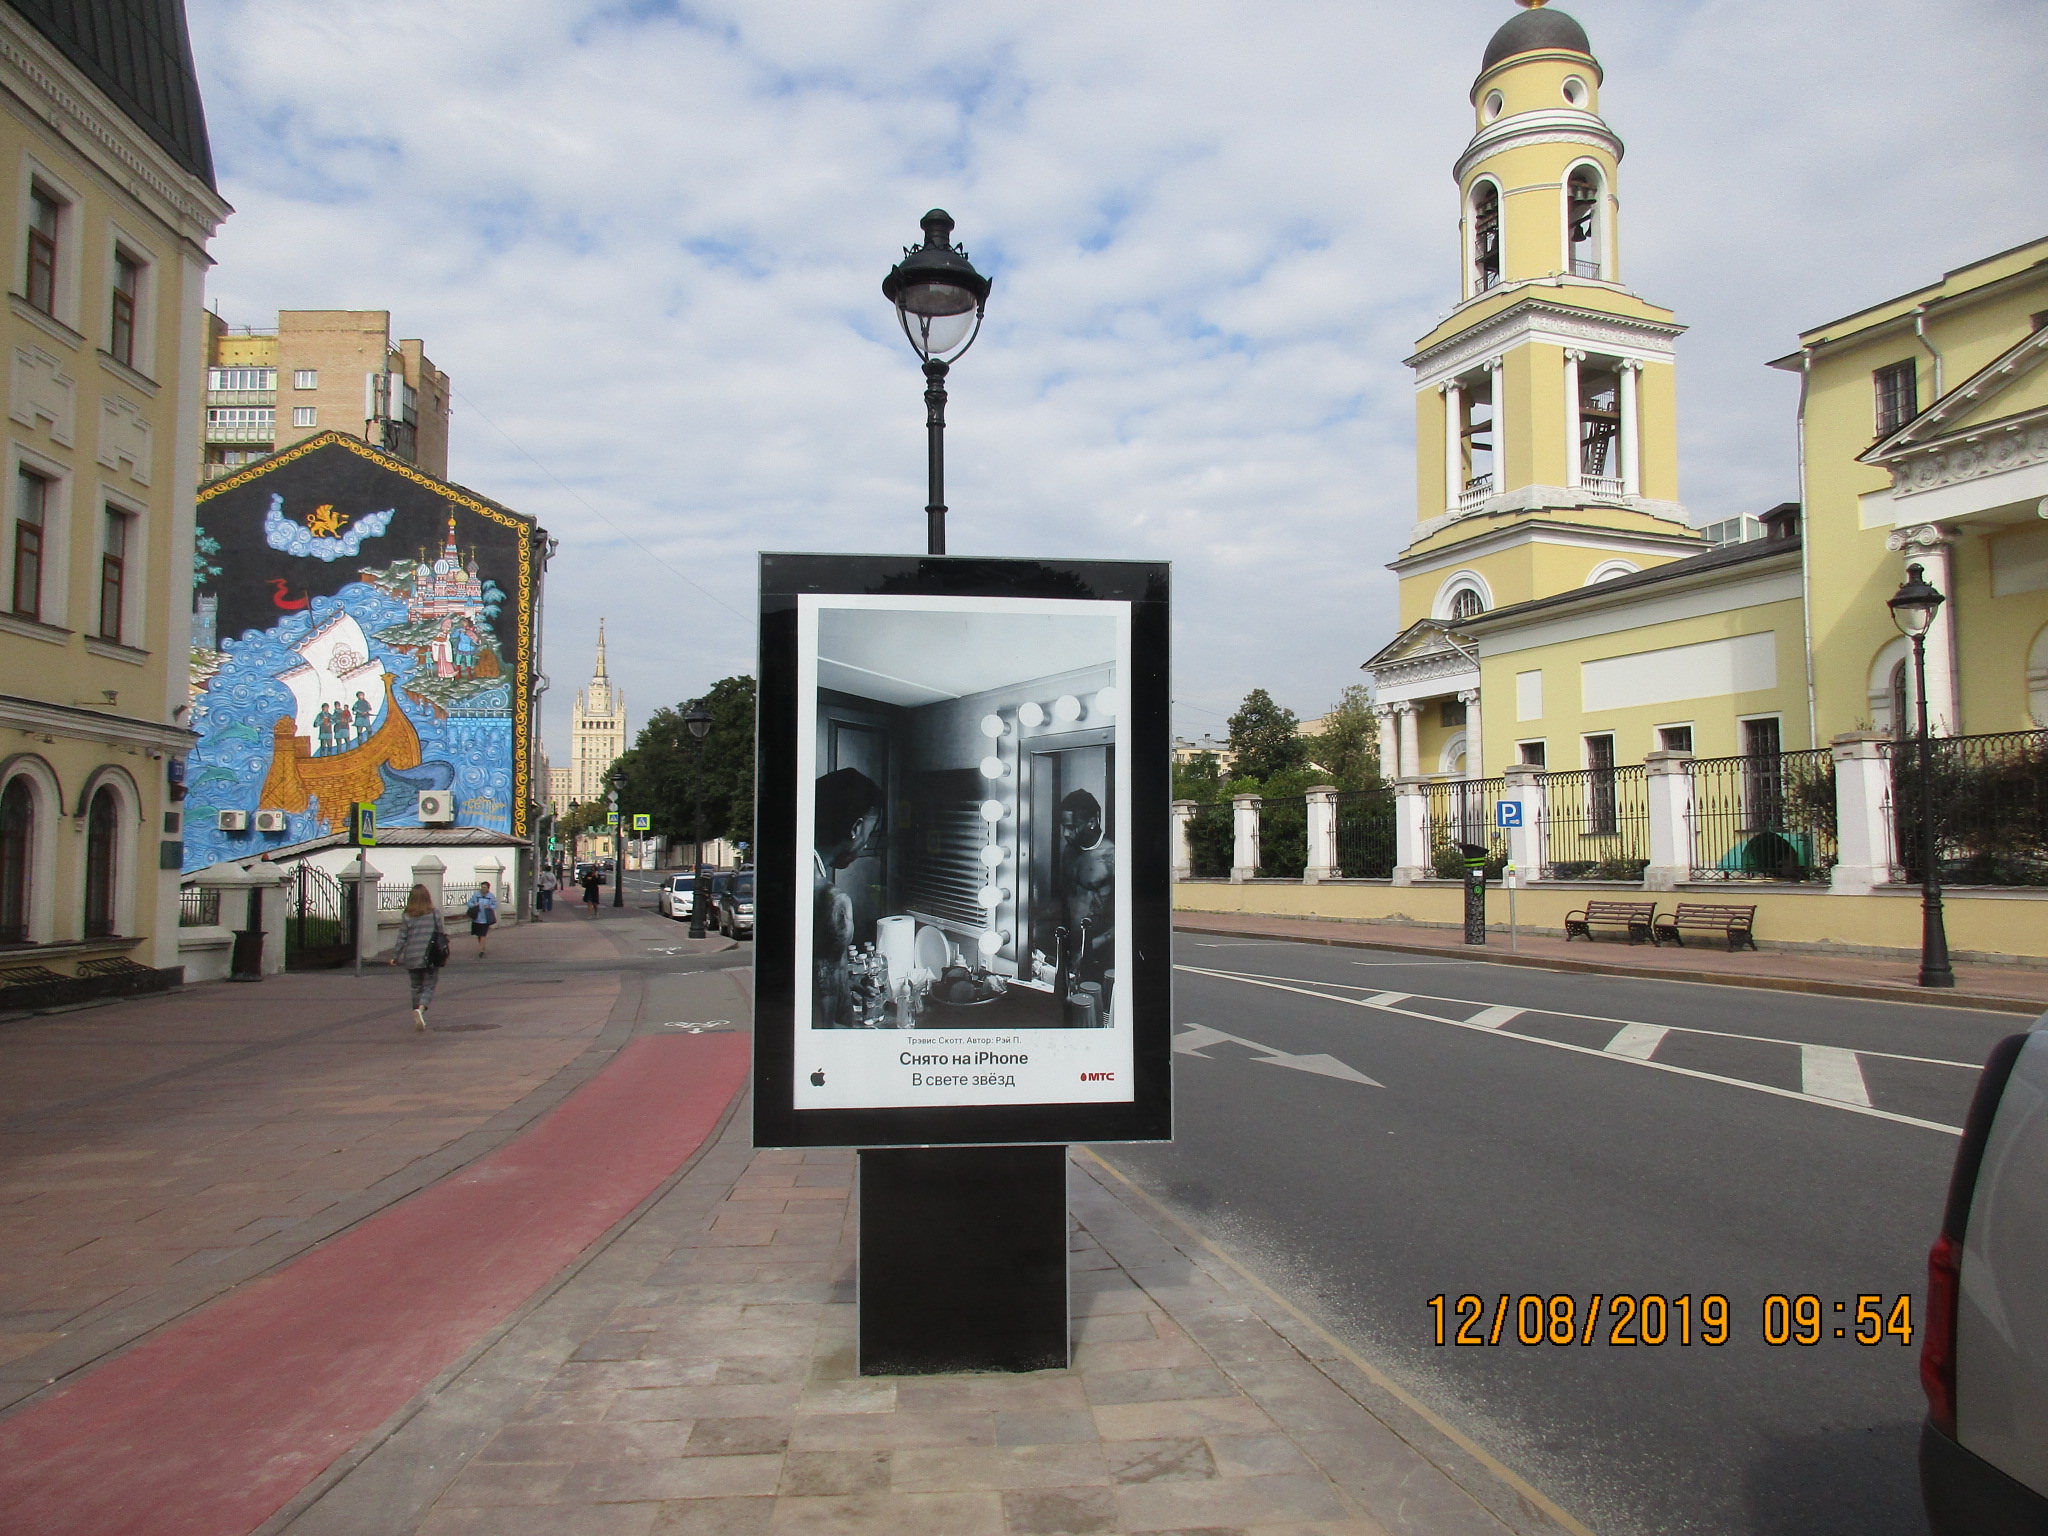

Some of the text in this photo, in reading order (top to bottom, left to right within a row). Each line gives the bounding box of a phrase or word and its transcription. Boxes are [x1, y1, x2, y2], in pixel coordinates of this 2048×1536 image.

[1501, 803, 1517, 825] P
[907, 1036, 1022, 1045] Трэвис Скотт. Автор: Рэй П.
[899, 1051, 1029, 1065] Снято на iPhone
[912, 1072, 1016, 1088] В свете звёзд
[1088, 1072, 1115, 1081] МТС
